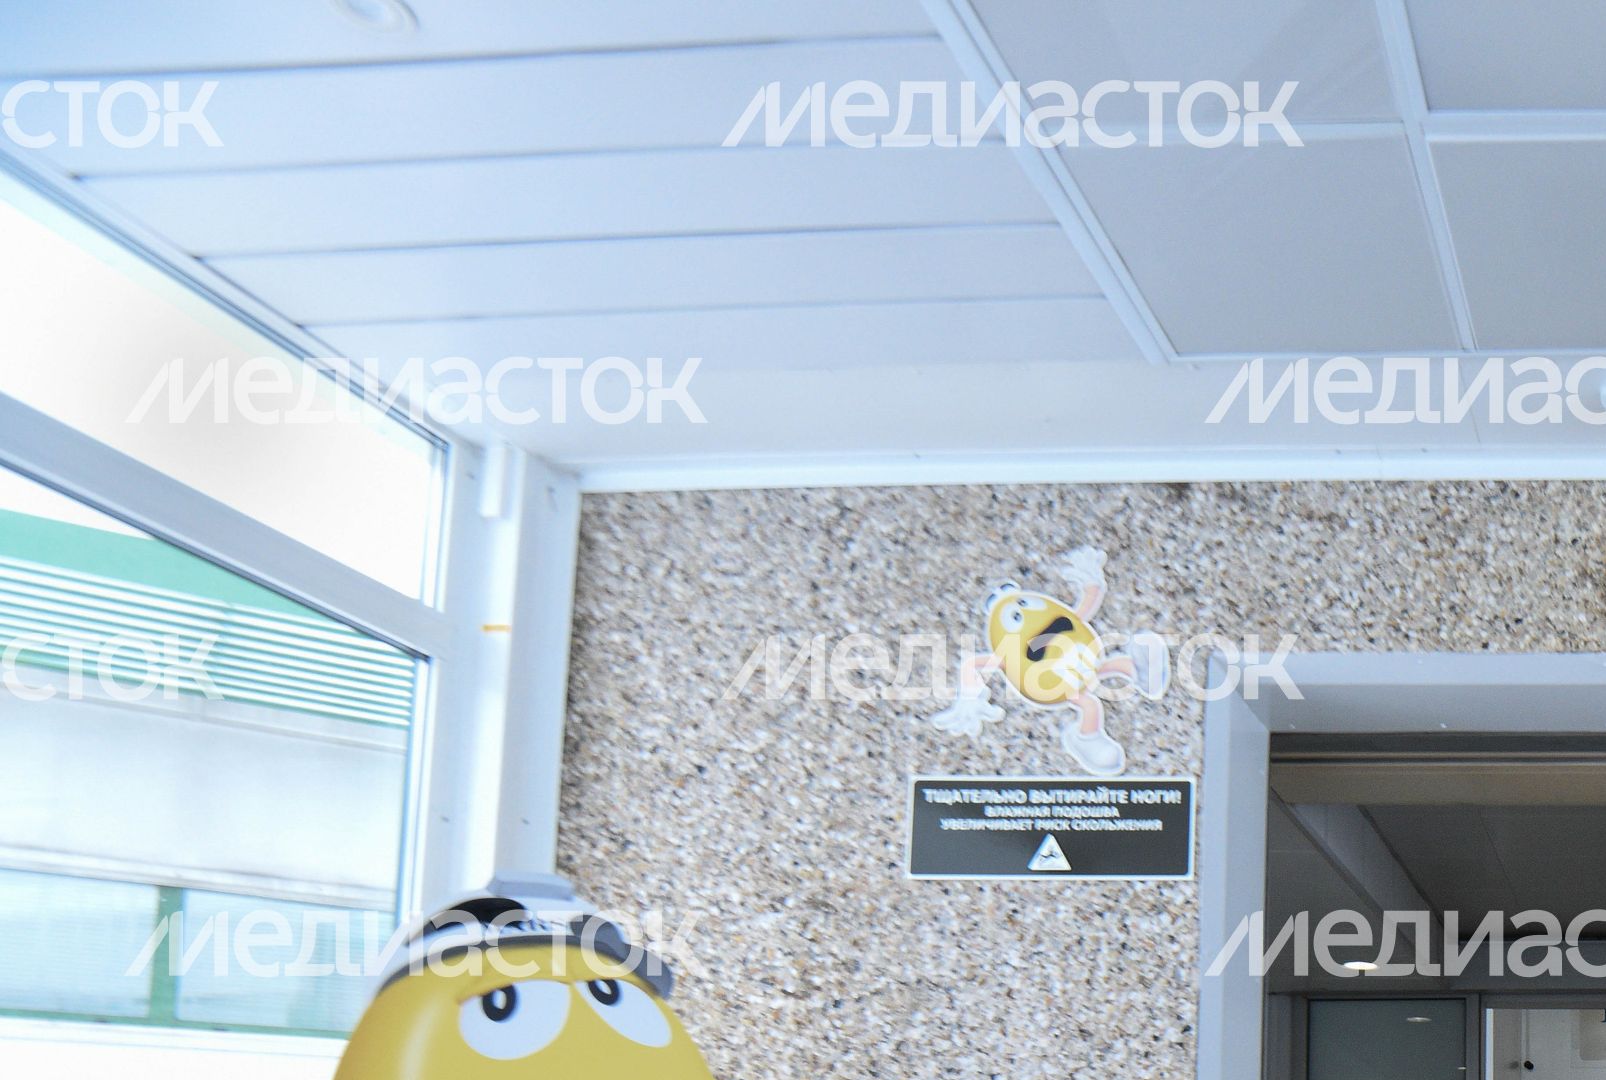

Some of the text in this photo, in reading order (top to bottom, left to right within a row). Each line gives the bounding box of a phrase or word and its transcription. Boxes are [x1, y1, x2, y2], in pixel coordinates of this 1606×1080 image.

[922, 785, 1182, 805] ТЩАТЕЛЬНО ВЫТИРАЙТЕ НОГИ!
[984, 805, 1120, 818] ВЛАЖНАЯ ПОДОШВА
[940, 818, 1163, 831] УВЕЛИЧИВАЕТ РИСК СКОЛЬЖЕНИЯ
